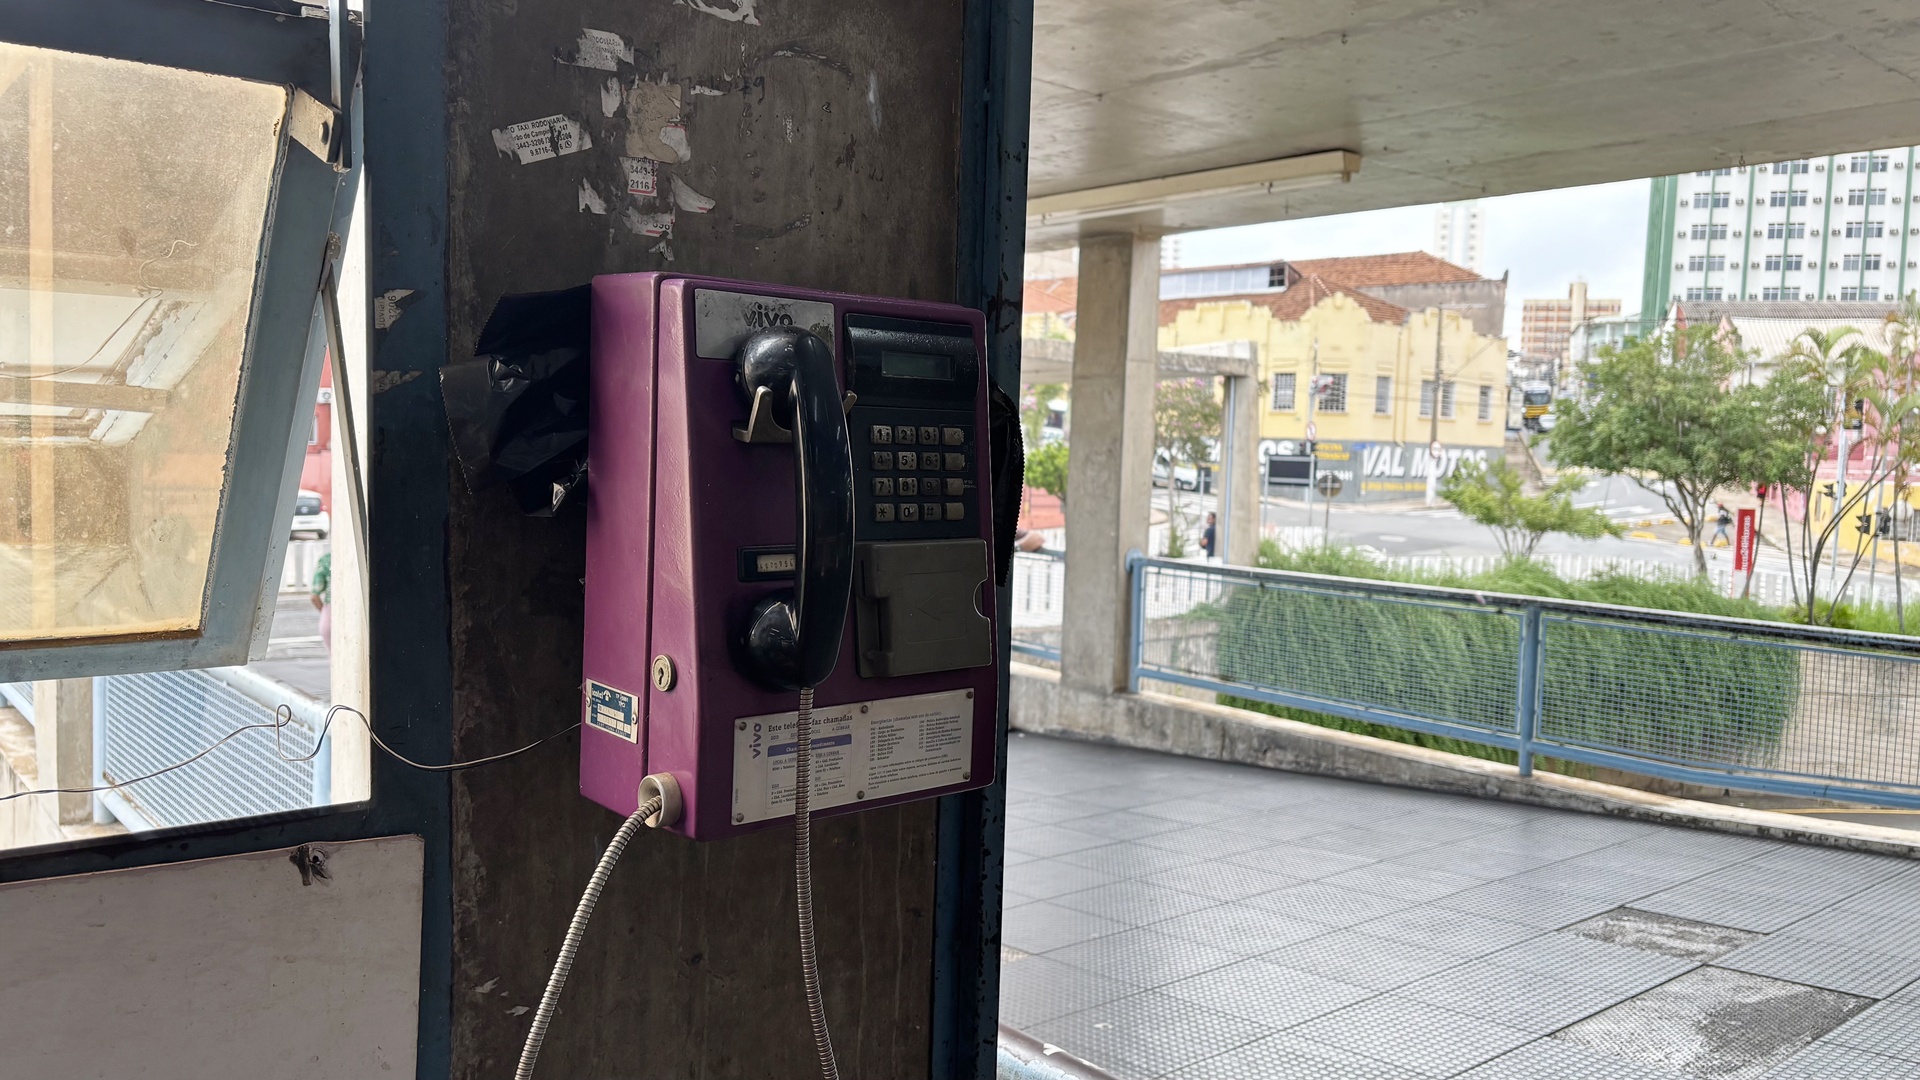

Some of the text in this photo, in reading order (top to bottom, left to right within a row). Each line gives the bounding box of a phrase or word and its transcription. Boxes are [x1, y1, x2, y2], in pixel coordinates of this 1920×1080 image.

[517, 123, 529, 131] TAXI
[514, 133, 523, 141] rão
[516, 138, 544, 150] 3443-3206
[630, 179, 650, 189] 2116
[743, 304, 793, 327] vivo
[877, 428, 882, 440] 1
[901, 430, 907, 440] 2
[924, 430, 930, 440] 3
[877, 455, 883, 465] 4
[901, 455, 908, 466] 5
[925, 456, 931, 465] 6
[1362, 445, 1405, 477] VAL
[878, 481, 885, 491] 7
[902, 481, 909, 491] 8
[926, 481, 933, 491] 9
[903, 507, 910, 517] 0
[768, 723, 782, 732] Este
[811, 718, 822, 726] faz
[823, 714, 853, 724] chamadas
[749, 723, 762, 759] vivo
